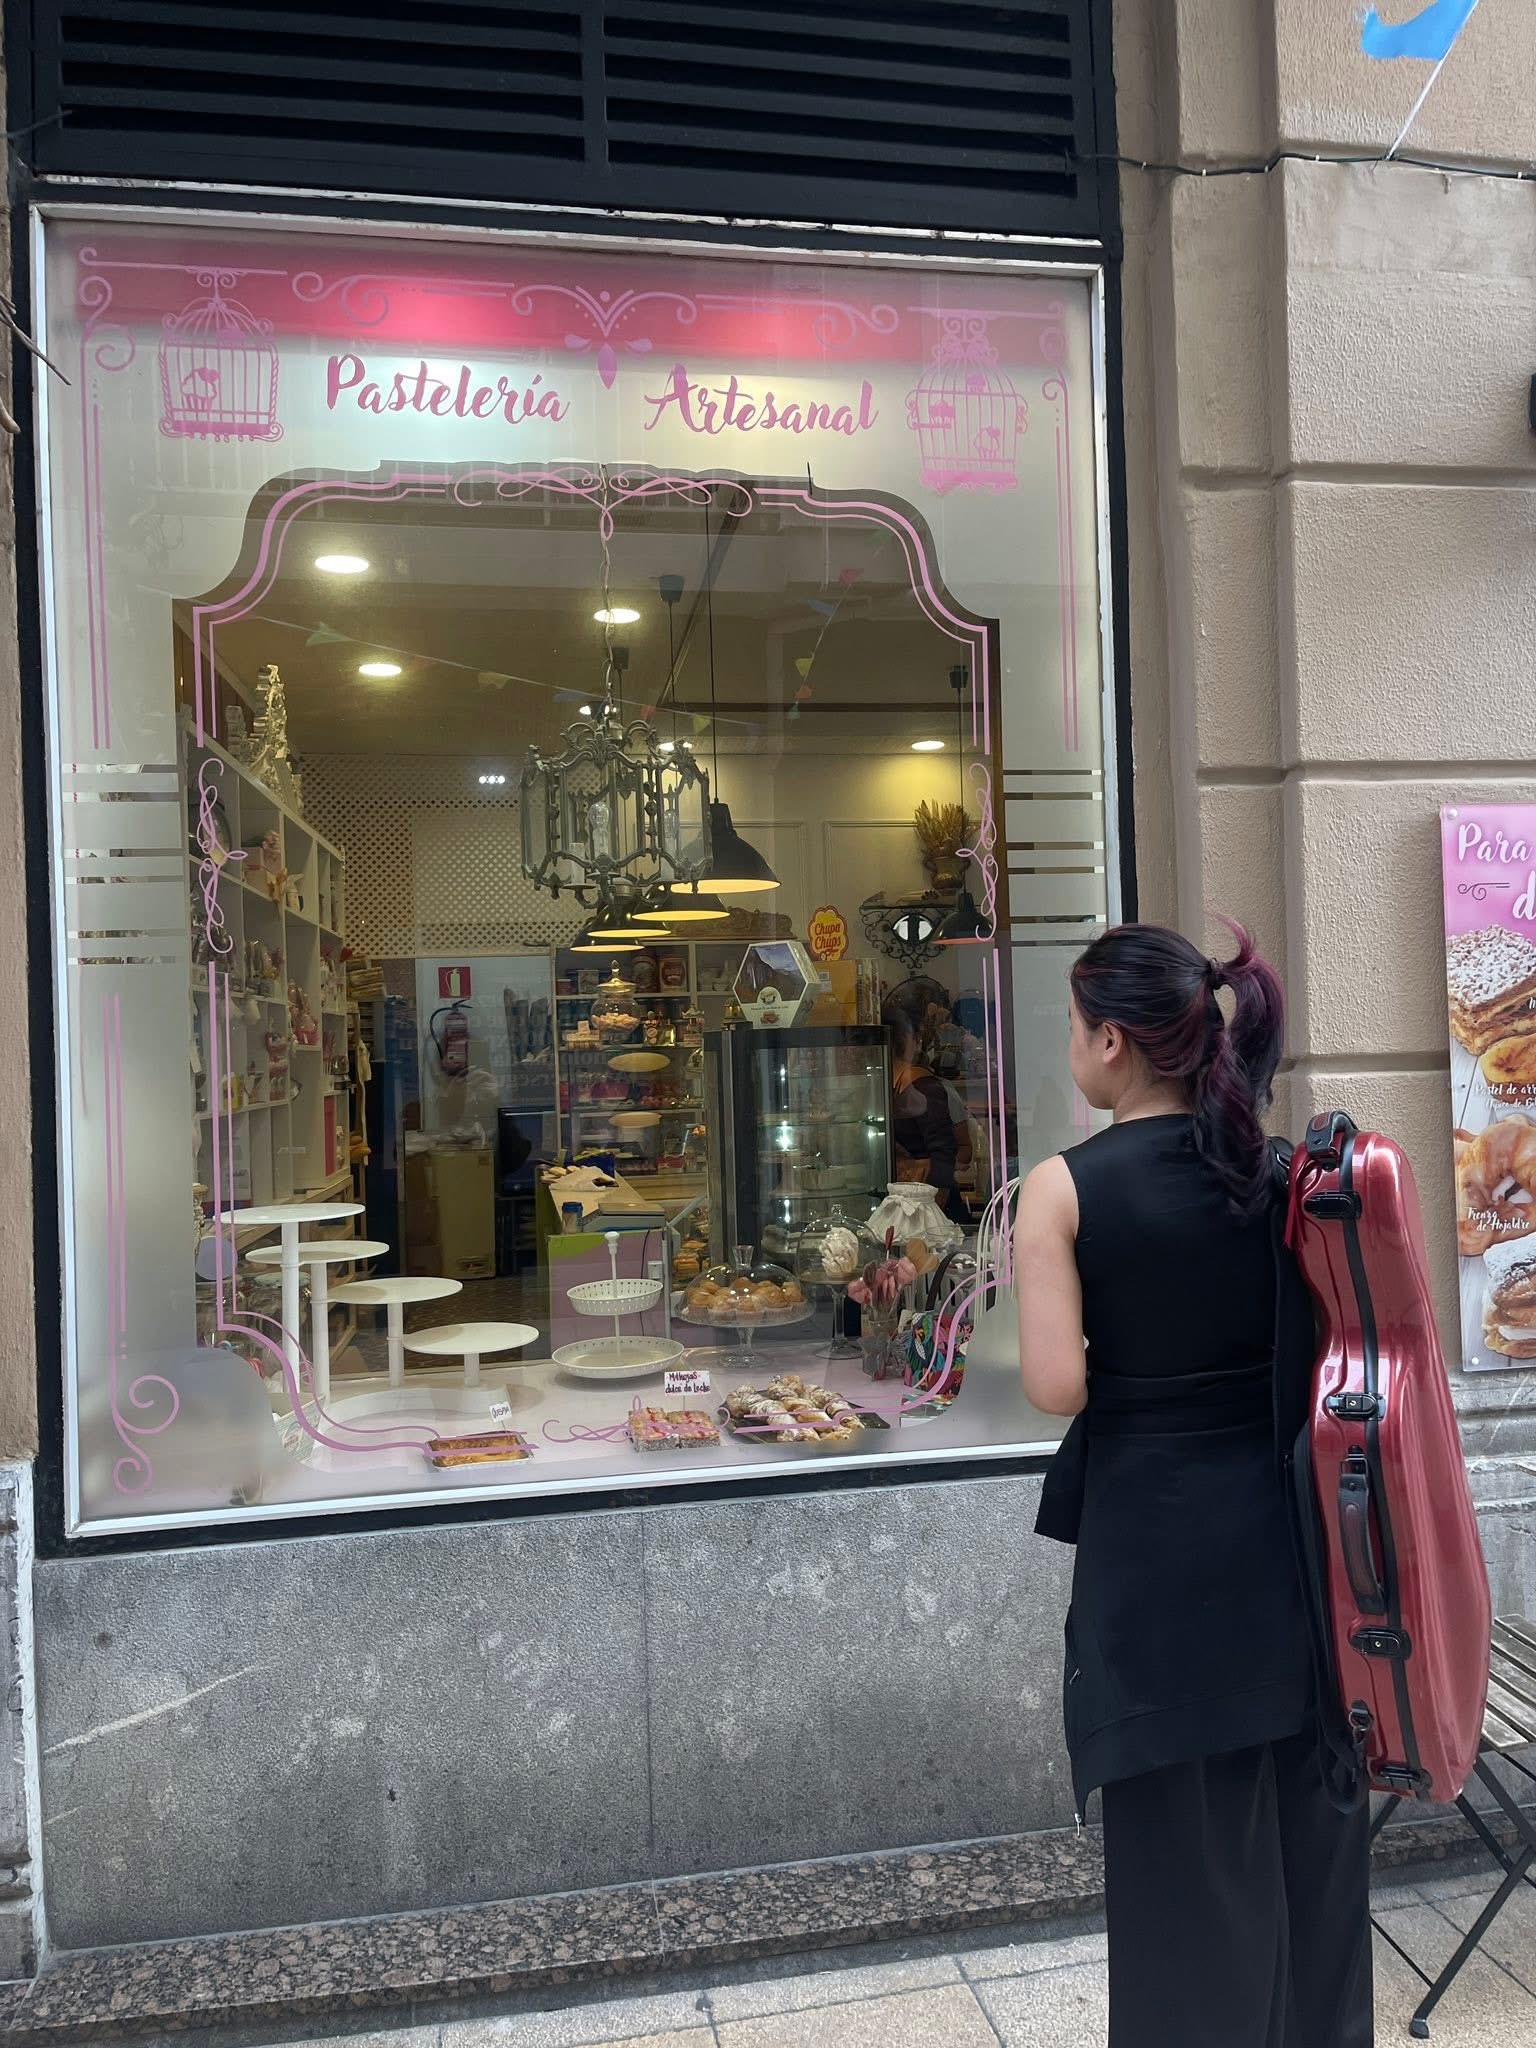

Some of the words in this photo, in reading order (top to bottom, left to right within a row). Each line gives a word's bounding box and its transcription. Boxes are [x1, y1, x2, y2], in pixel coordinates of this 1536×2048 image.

[326, 353, 571, 425] Pastelería
[644, 363, 879, 436] Artesanal
[1458, 822, 1534, 864] Para
[1512, 870, 1536, 920] d
[815, 923, 841, 937] Chupa
[815, 936, 841, 952] Chups
[1475, 1083, 1503, 1095] Pastel
[1506, 1083, 1517, 1095] de
[1521, 1084, 1536, 1095] arr
[1464, 1206, 1498, 1224] Trenza
[1476, 1220, 1488, 1231] de
[1489, 1217, 1530, 1234] Hojaldre
[665, 1383, 682, 1393] dulce
[684, 1383, 692, 1392] de
